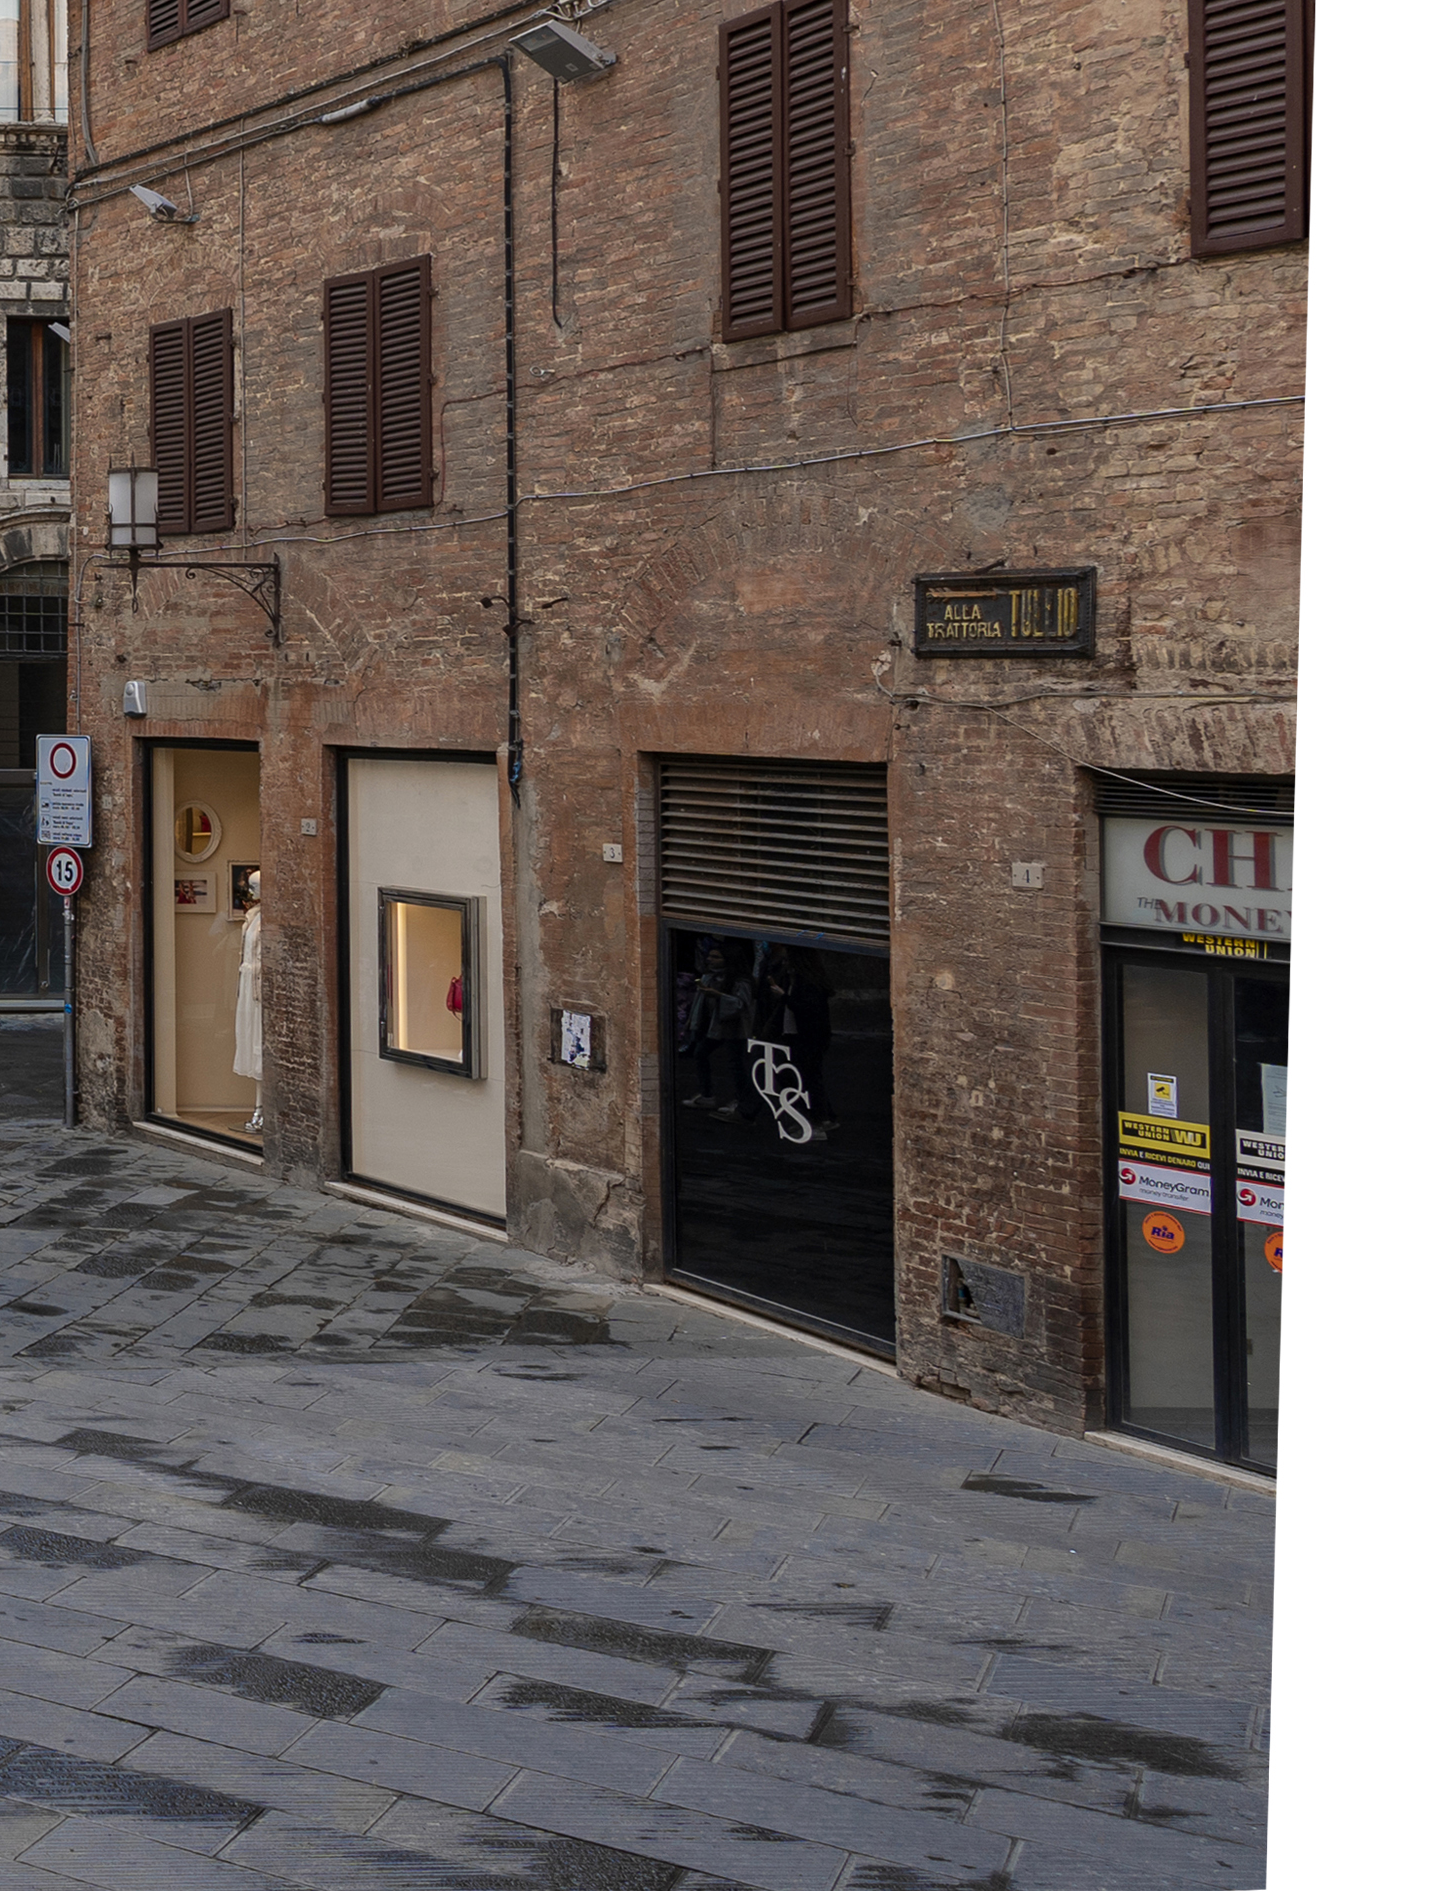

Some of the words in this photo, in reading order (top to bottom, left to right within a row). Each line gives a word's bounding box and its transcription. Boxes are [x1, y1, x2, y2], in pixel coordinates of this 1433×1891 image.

[944, 604, 981, 620] ALLA
[926, 622, 1002, 638] TRATTORIA
[610, 847, 615, 858] 3
[1143, 825, 1292, 892] CH
[56, 860, 73, 881] 15
[1022, 869, 1030, 883] 4
[1137, 896, 1160, 909] THE
[1154, 899, 1291, 934] MONE
[1182, 933, 1256, 949] WESTERN
[1205, 944, 1256, 958] UNION
[1124, 1121, 1170, 1134] WESTERN
[1138, 1130, 1170, 1141] UNION
[1120, 1147, 1138, 1157] INVIA
[1145, 1152, 1166, 1162] RICEVI
[1168, 1156, 1196, 1167] DENARO
[1237, 1168, 1257, 1178] INVIA
[1139, 1176, 1210, 1197] MoneyGram
[1139, 1188, 1161, 1197] money
[1162, 1191, 1189, 1201] transfer
[1151, 1226, 1175, 1240] Ria
